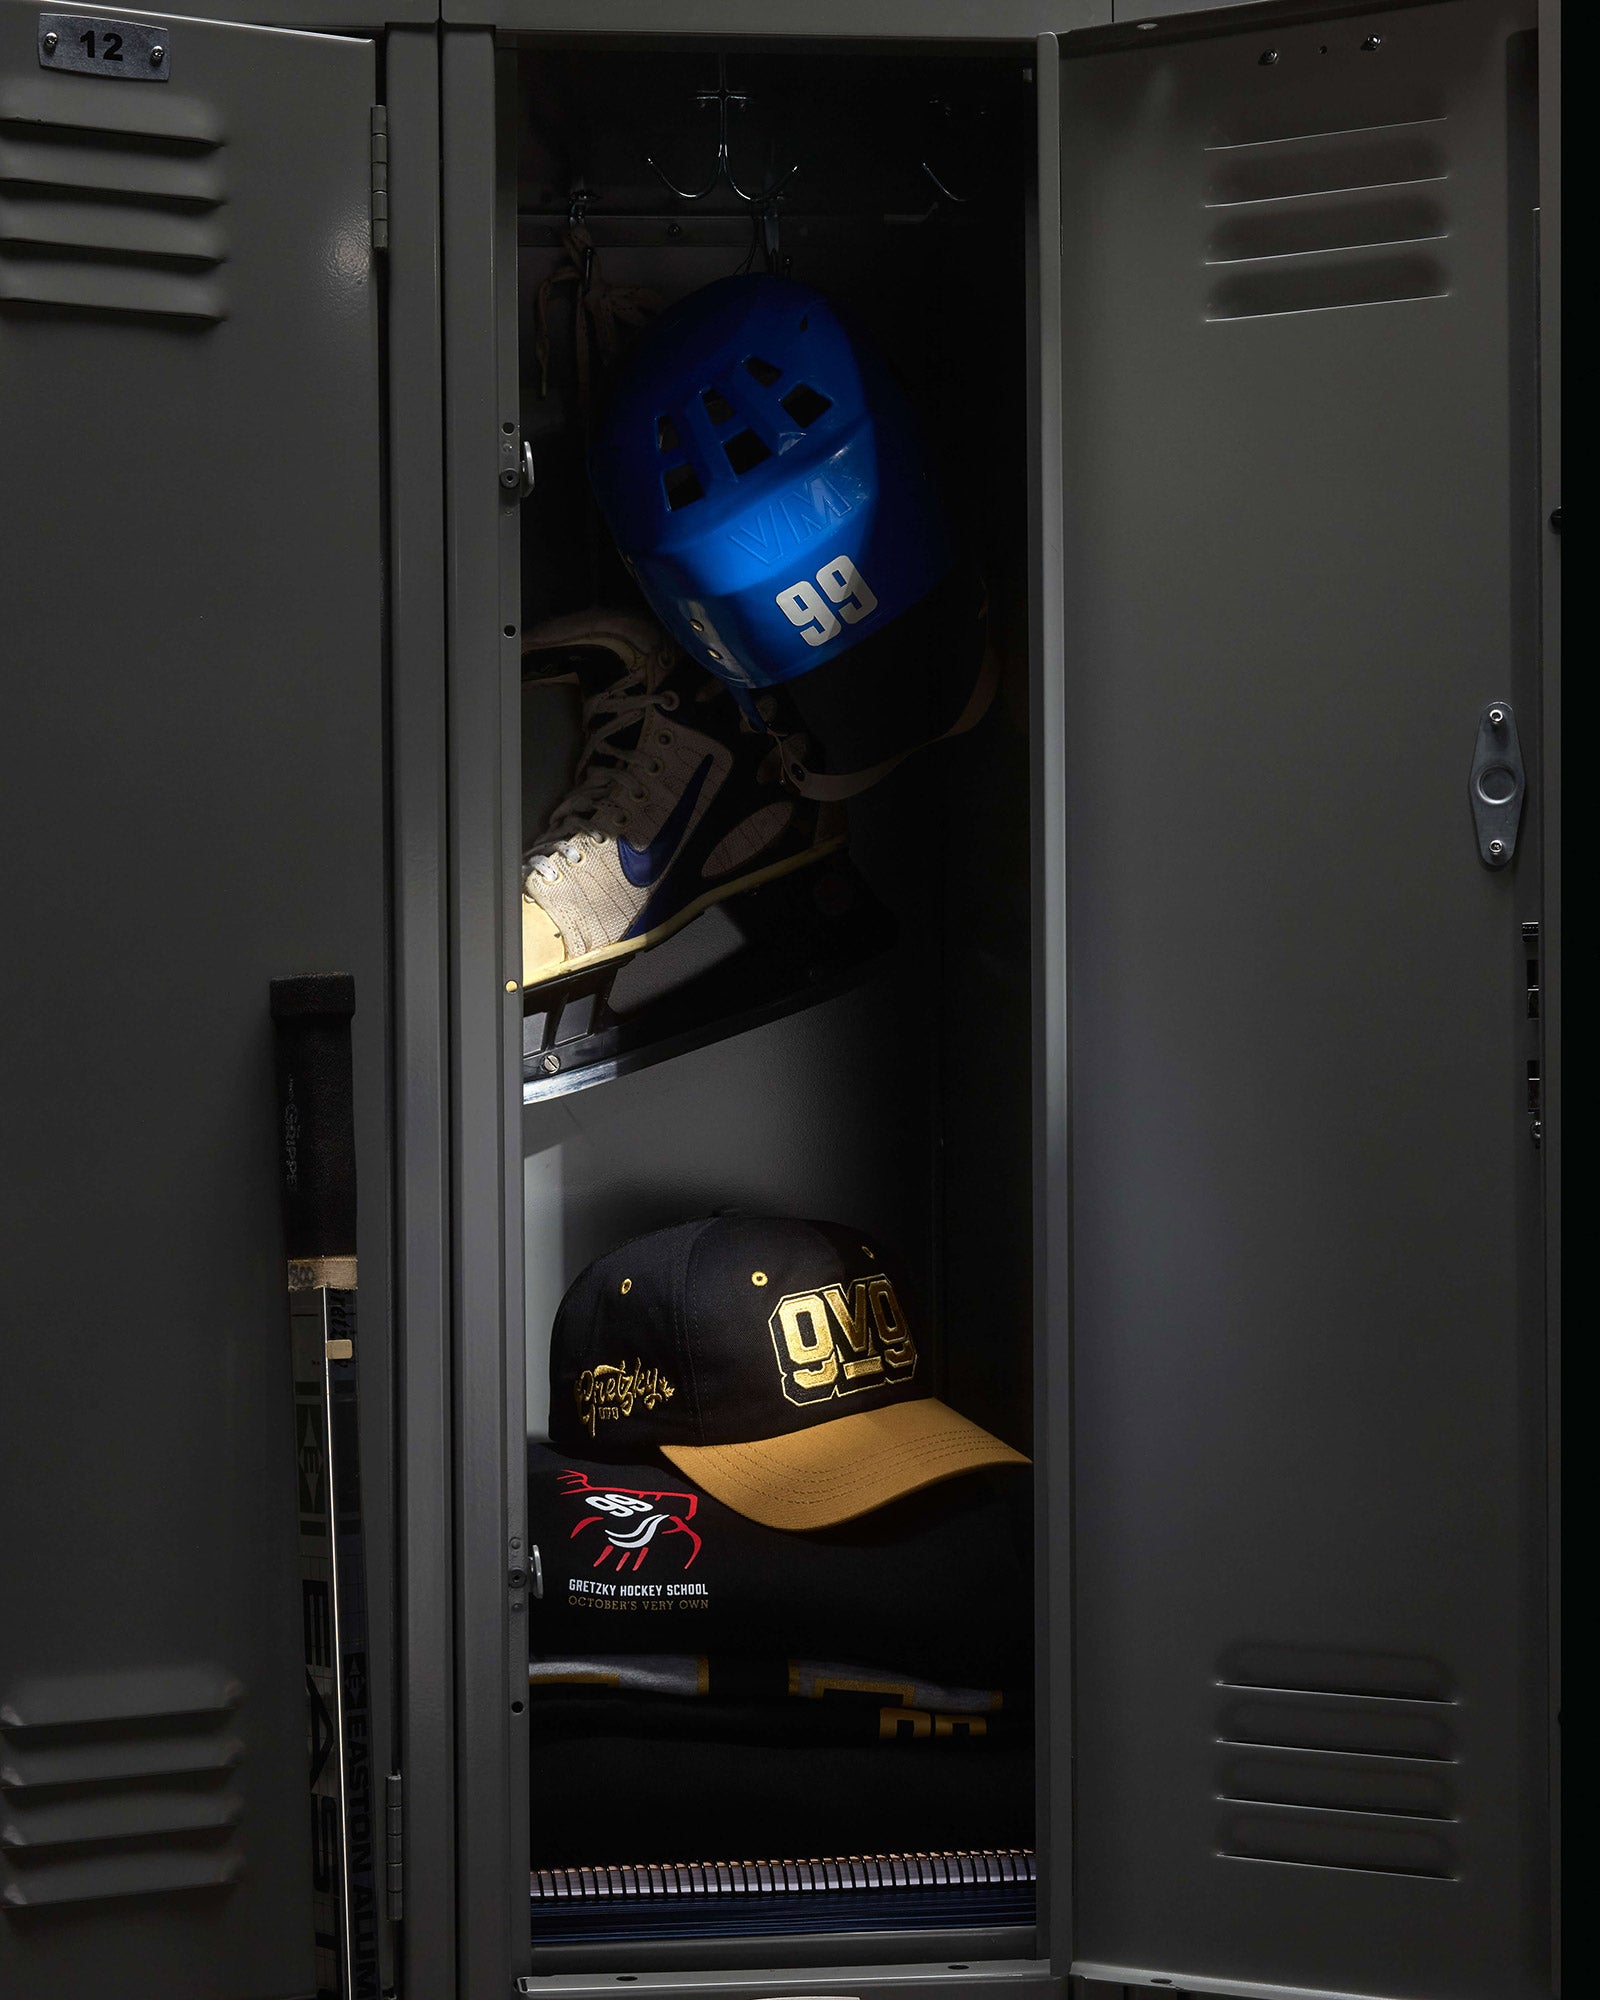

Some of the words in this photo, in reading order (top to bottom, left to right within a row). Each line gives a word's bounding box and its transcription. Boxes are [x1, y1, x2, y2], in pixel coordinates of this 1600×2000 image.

[80, 30, 123, 61] 12
[776, 555, 878, 647] 99
[573, 1356, 663, 1438] Gretzky
[584, 1493, 654, 1518] 99
[568, 1578, 617, 1597] GRETZKY
[620, 1583, 663, 1597] HOCKEY
[666, 1582, 709, 1596] SCHOOL
[568, 1594, 638, 1611] OCTOBER'S
[642, 1599, 675, 1611] VERY
[678, 1599, 710, 1610] OWN
[302, 1579, 342, 2000] EAST
[343, 1712, 373, 1874] EASTON
